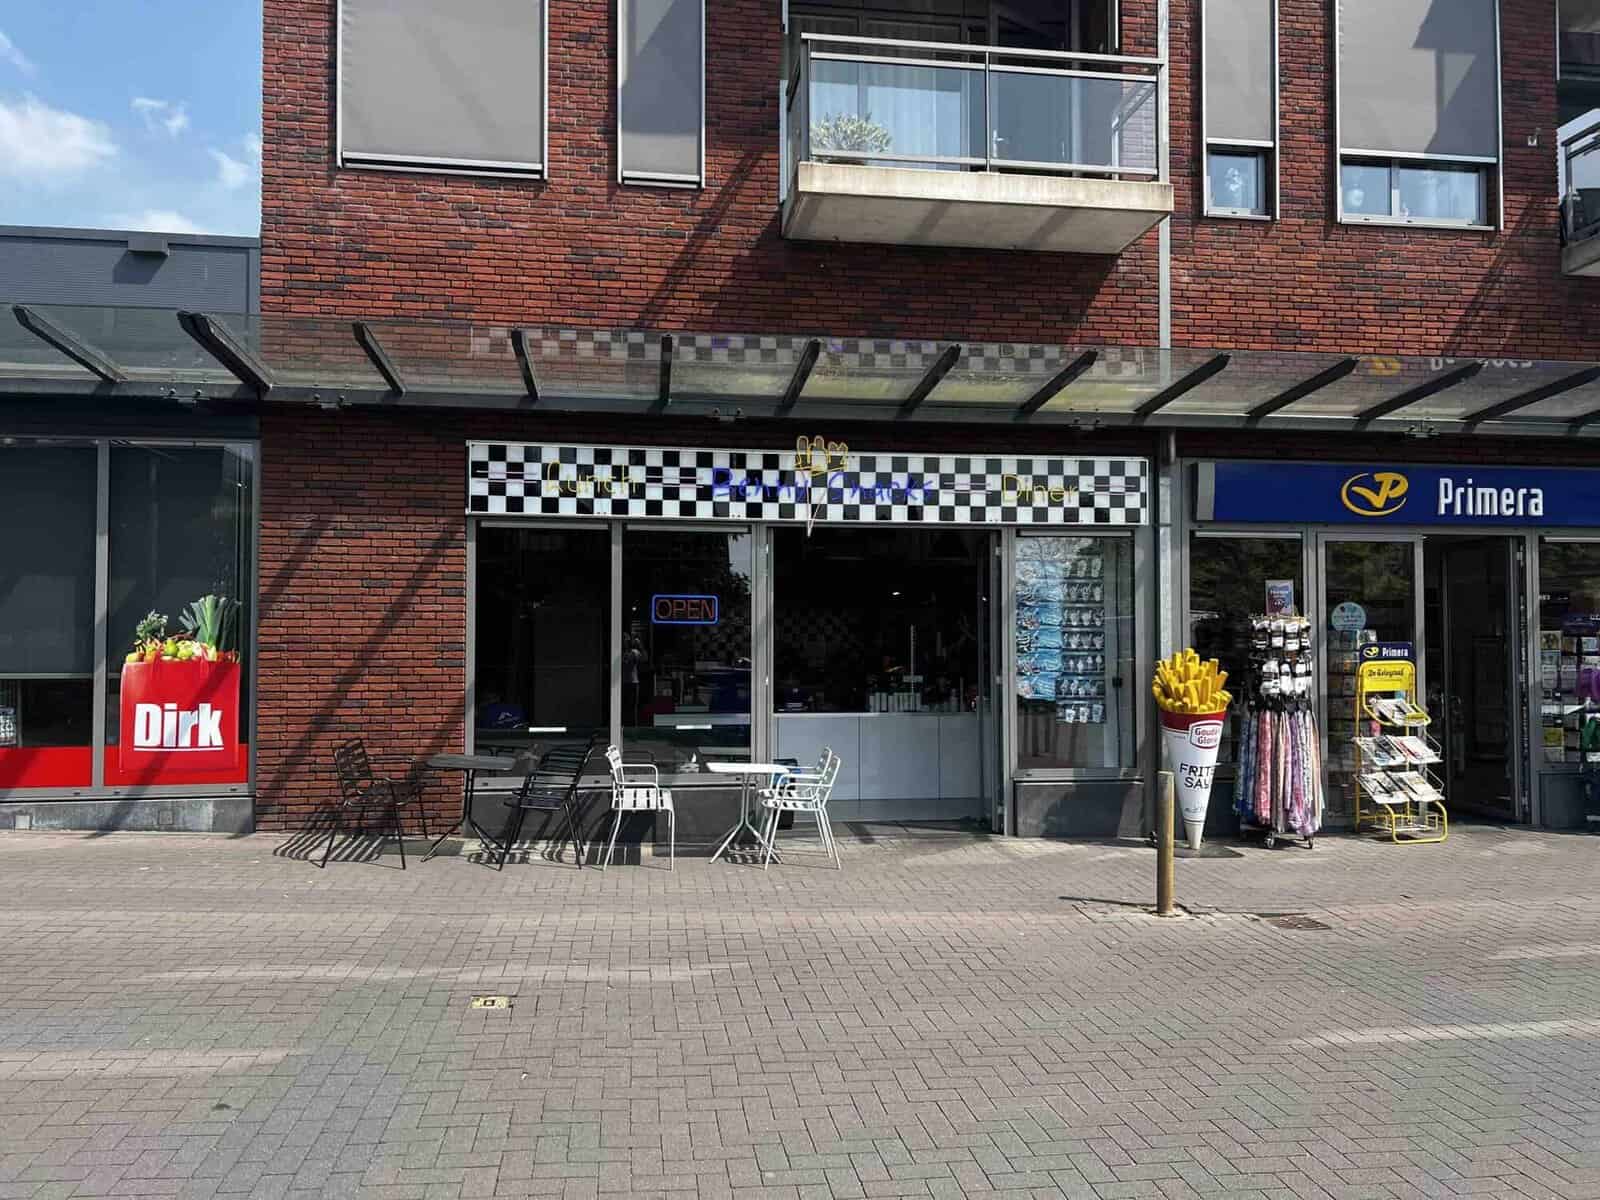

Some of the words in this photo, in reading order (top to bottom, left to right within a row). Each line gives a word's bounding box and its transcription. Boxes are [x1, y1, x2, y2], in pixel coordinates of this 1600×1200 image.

[1003, 474, 1079, 503] Diner
[1437, 477, 1545, 517] Primera
[656, 598, 715, 620] OPEN
[1382, 647, 1409, 657] Primera
[133, 703, 224, 747] Dirk
